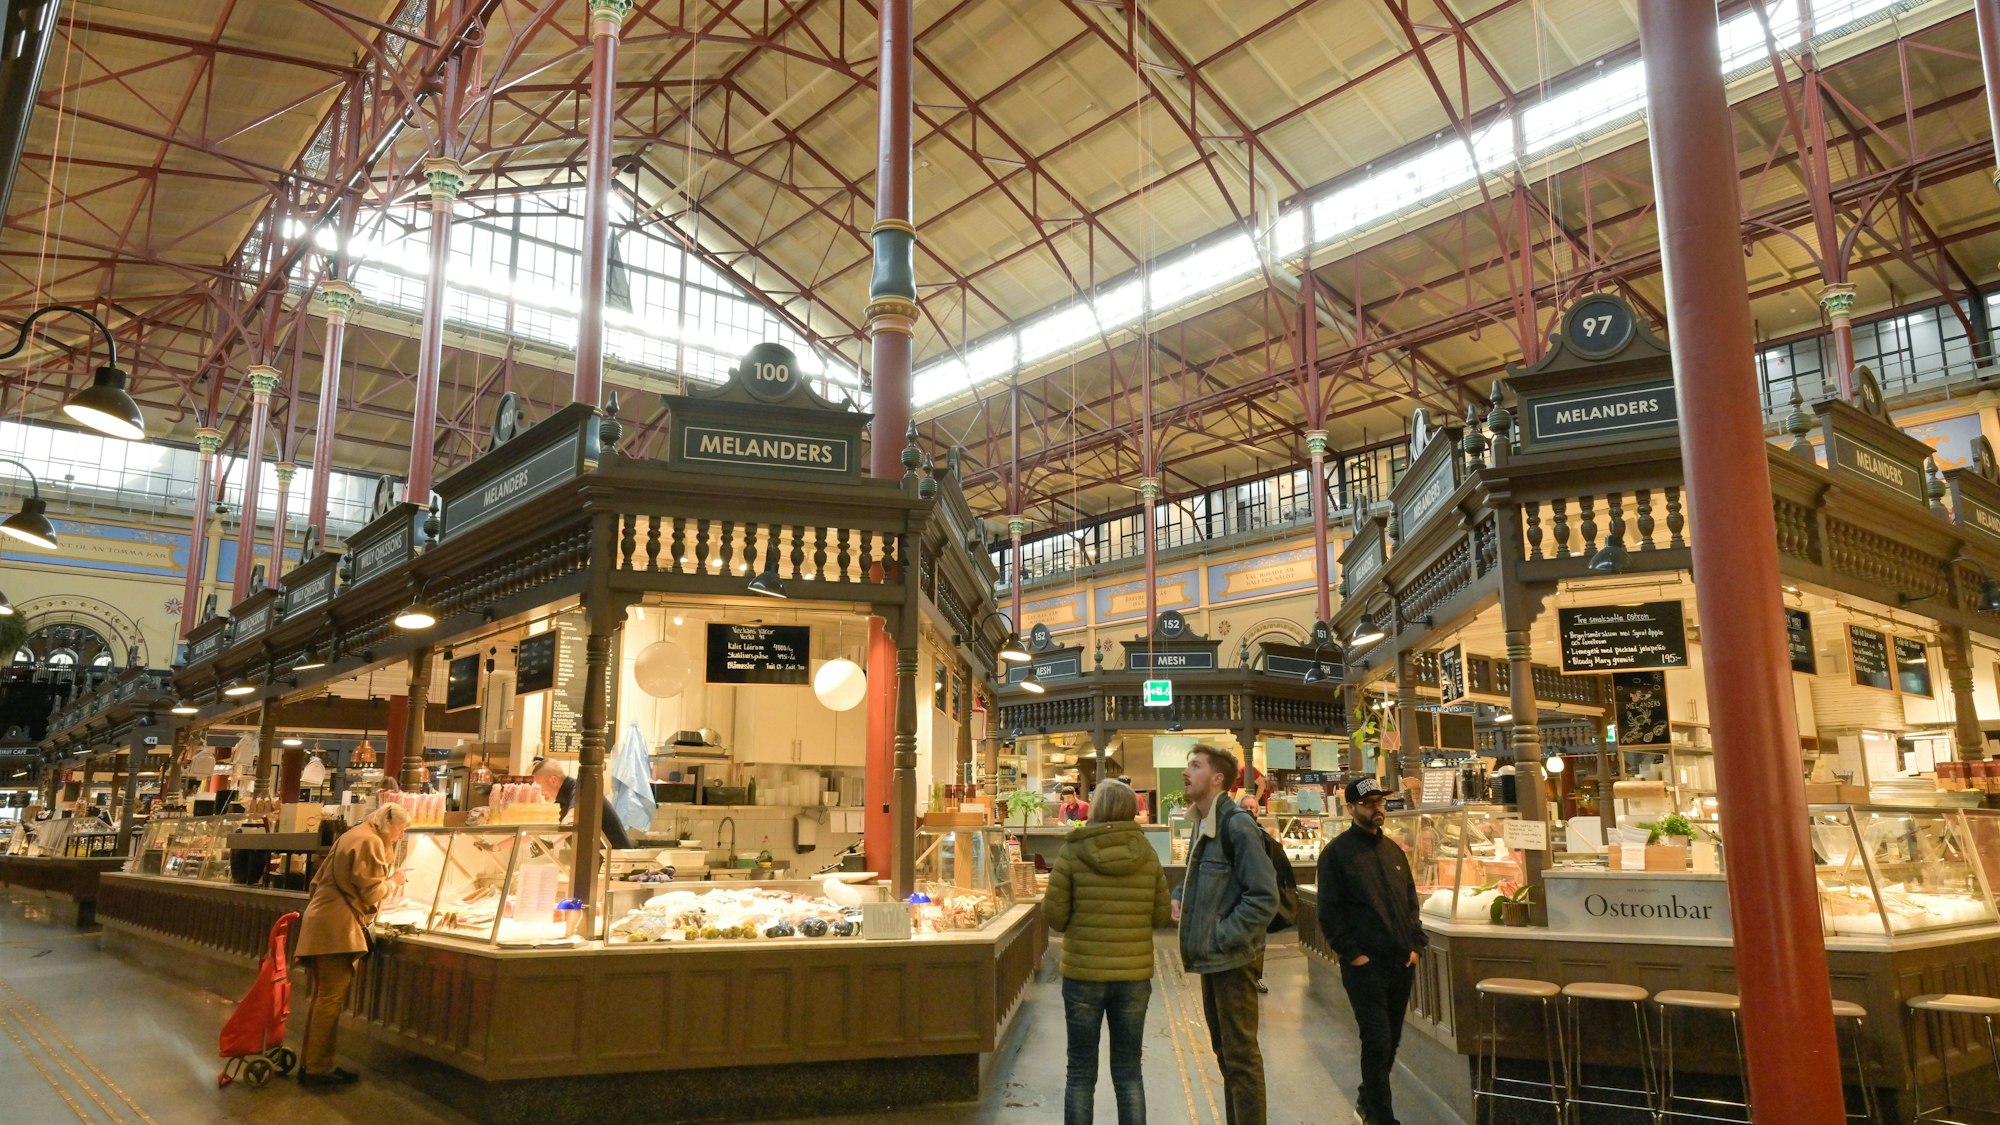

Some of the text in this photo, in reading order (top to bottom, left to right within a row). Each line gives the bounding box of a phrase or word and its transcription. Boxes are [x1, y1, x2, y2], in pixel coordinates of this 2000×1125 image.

[1582, 315, 1613, 337] 97
[754, 362, 789, 383] 100
[1863, 384, 1875, 403] 96
[500, 409, 513, 430] 100
[1556, 398, 1659, 424] MELANDERS
[699, 434, 833, 464] MELANDERS
[1856, 450, 1904, 486] MELANDERS
[483, 469, 529, 507] MELANDERS
[1413, 480, 1440, 521] MELANDERS
[361, 534, 402, 569] WILLY OHLSSONS
[1163, 619, 1180, 629] 152
[1574, 614, 1588, 624] Tre
[1589, 613, 1624, 623] smaksatta
[1034, 631, 1046, 641] 152
[1317, 629, 1327, 639] 151
[1157, 656, 1186, 665] MESH
[1572, 656, 1593, 667] Bloody
[1595, 656, 1611, 666] Mary
[1625, 700, 1661, 709] MELANDERS
[1584, 893, 1712, 920] Ostronbar
